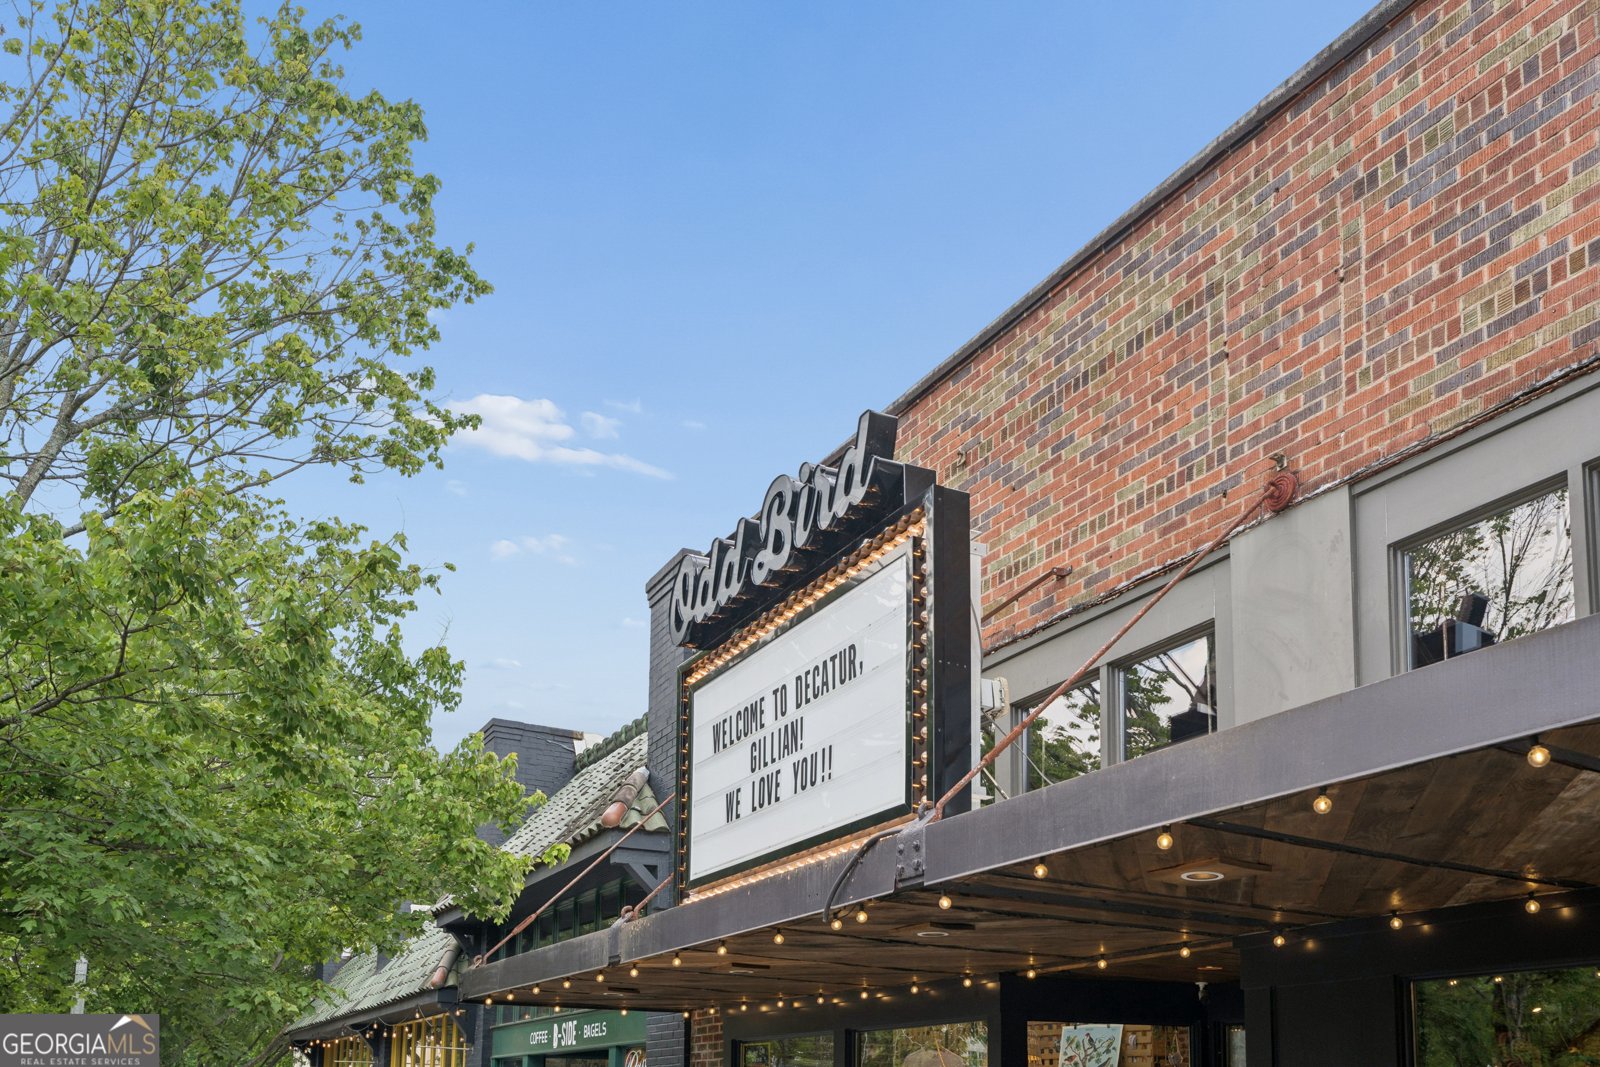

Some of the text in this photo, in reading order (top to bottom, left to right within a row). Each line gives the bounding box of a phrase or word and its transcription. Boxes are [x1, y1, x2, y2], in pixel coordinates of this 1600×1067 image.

[669, 409, 879, 645] Odd Bird
[712, 643, 864, 754] WELCOME TO DECATUR,
[726, 744, 833, 823] WE LOVE YOU!!
[750, 716, 804, 773] GILLIAN!
[529, 1020, 607, 1049] COFFEE B-SIDE BAGELS
